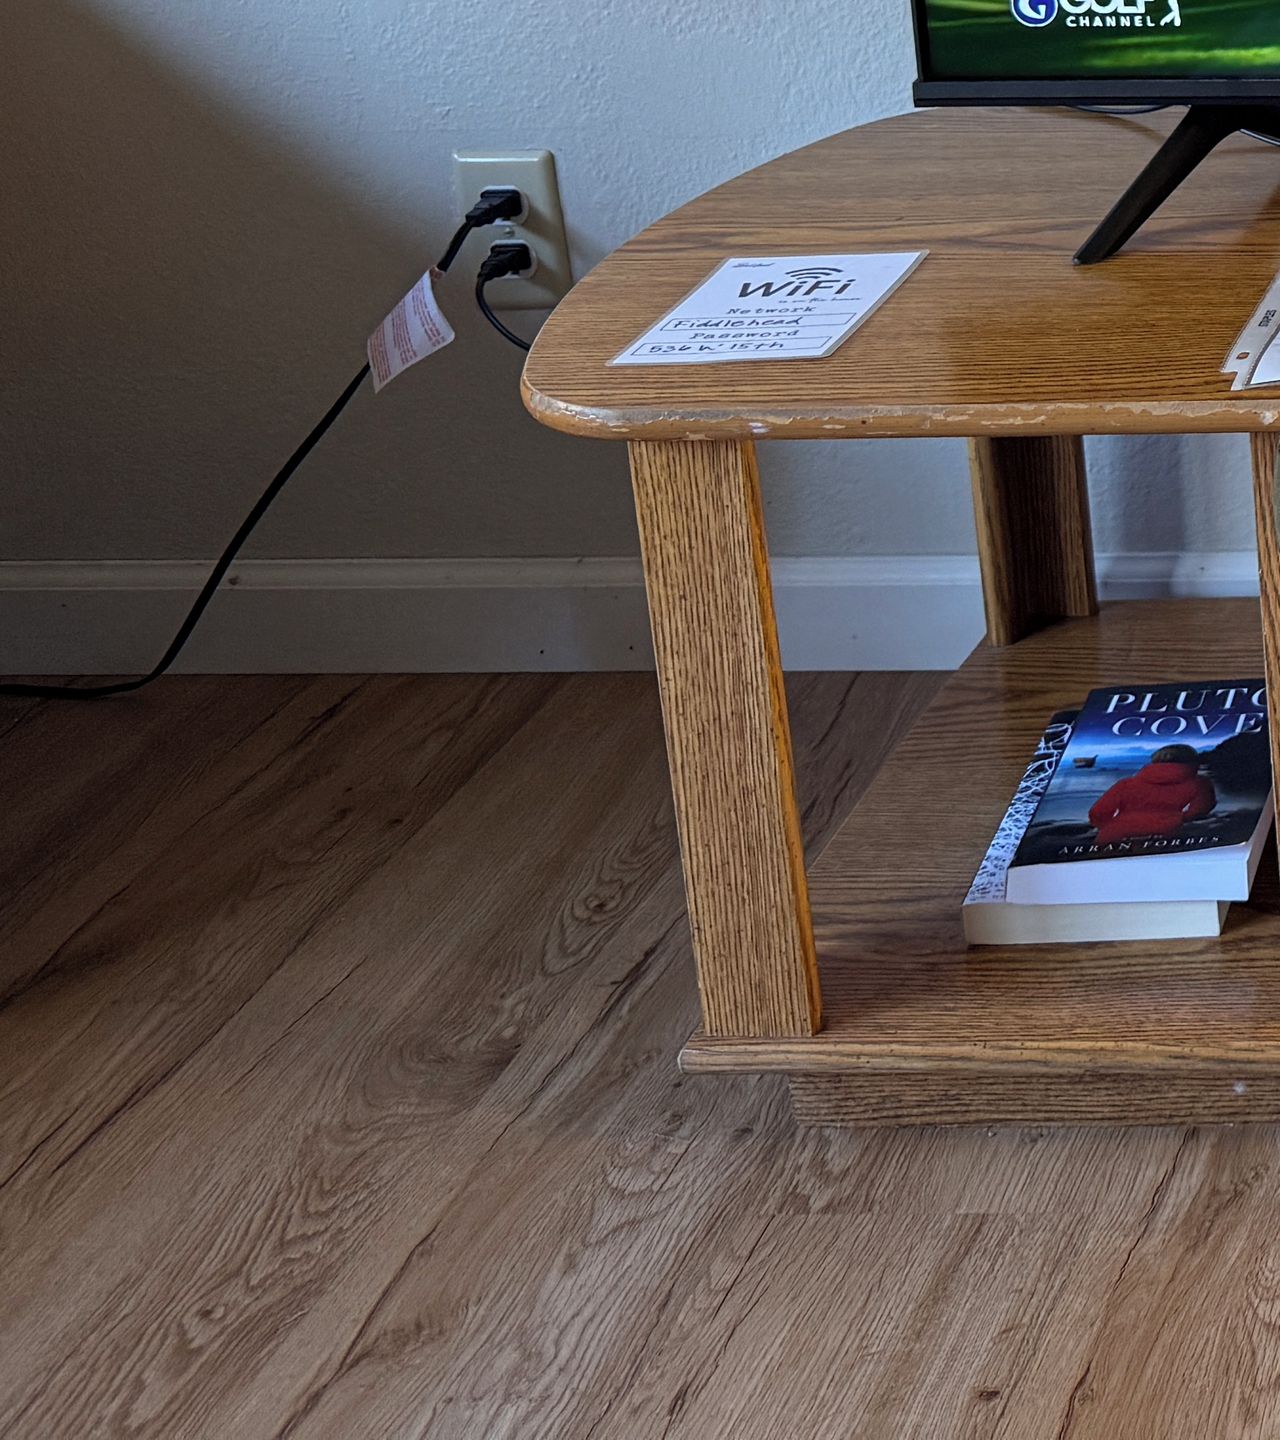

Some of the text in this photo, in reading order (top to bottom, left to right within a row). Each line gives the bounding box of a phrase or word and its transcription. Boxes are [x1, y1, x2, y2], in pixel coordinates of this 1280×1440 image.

[1065, 15, 1156, 27] CHANNEL
[738, 279, 856, 298] WiFi
[726, 306, 816, 315] Network
[673, 317, 804, 329] Fiddlehead
[688, 330, 800, 340] Password
[1112, 712, 1265, 737] COVE
[1058, 842, 1132, 854] ARRAN
